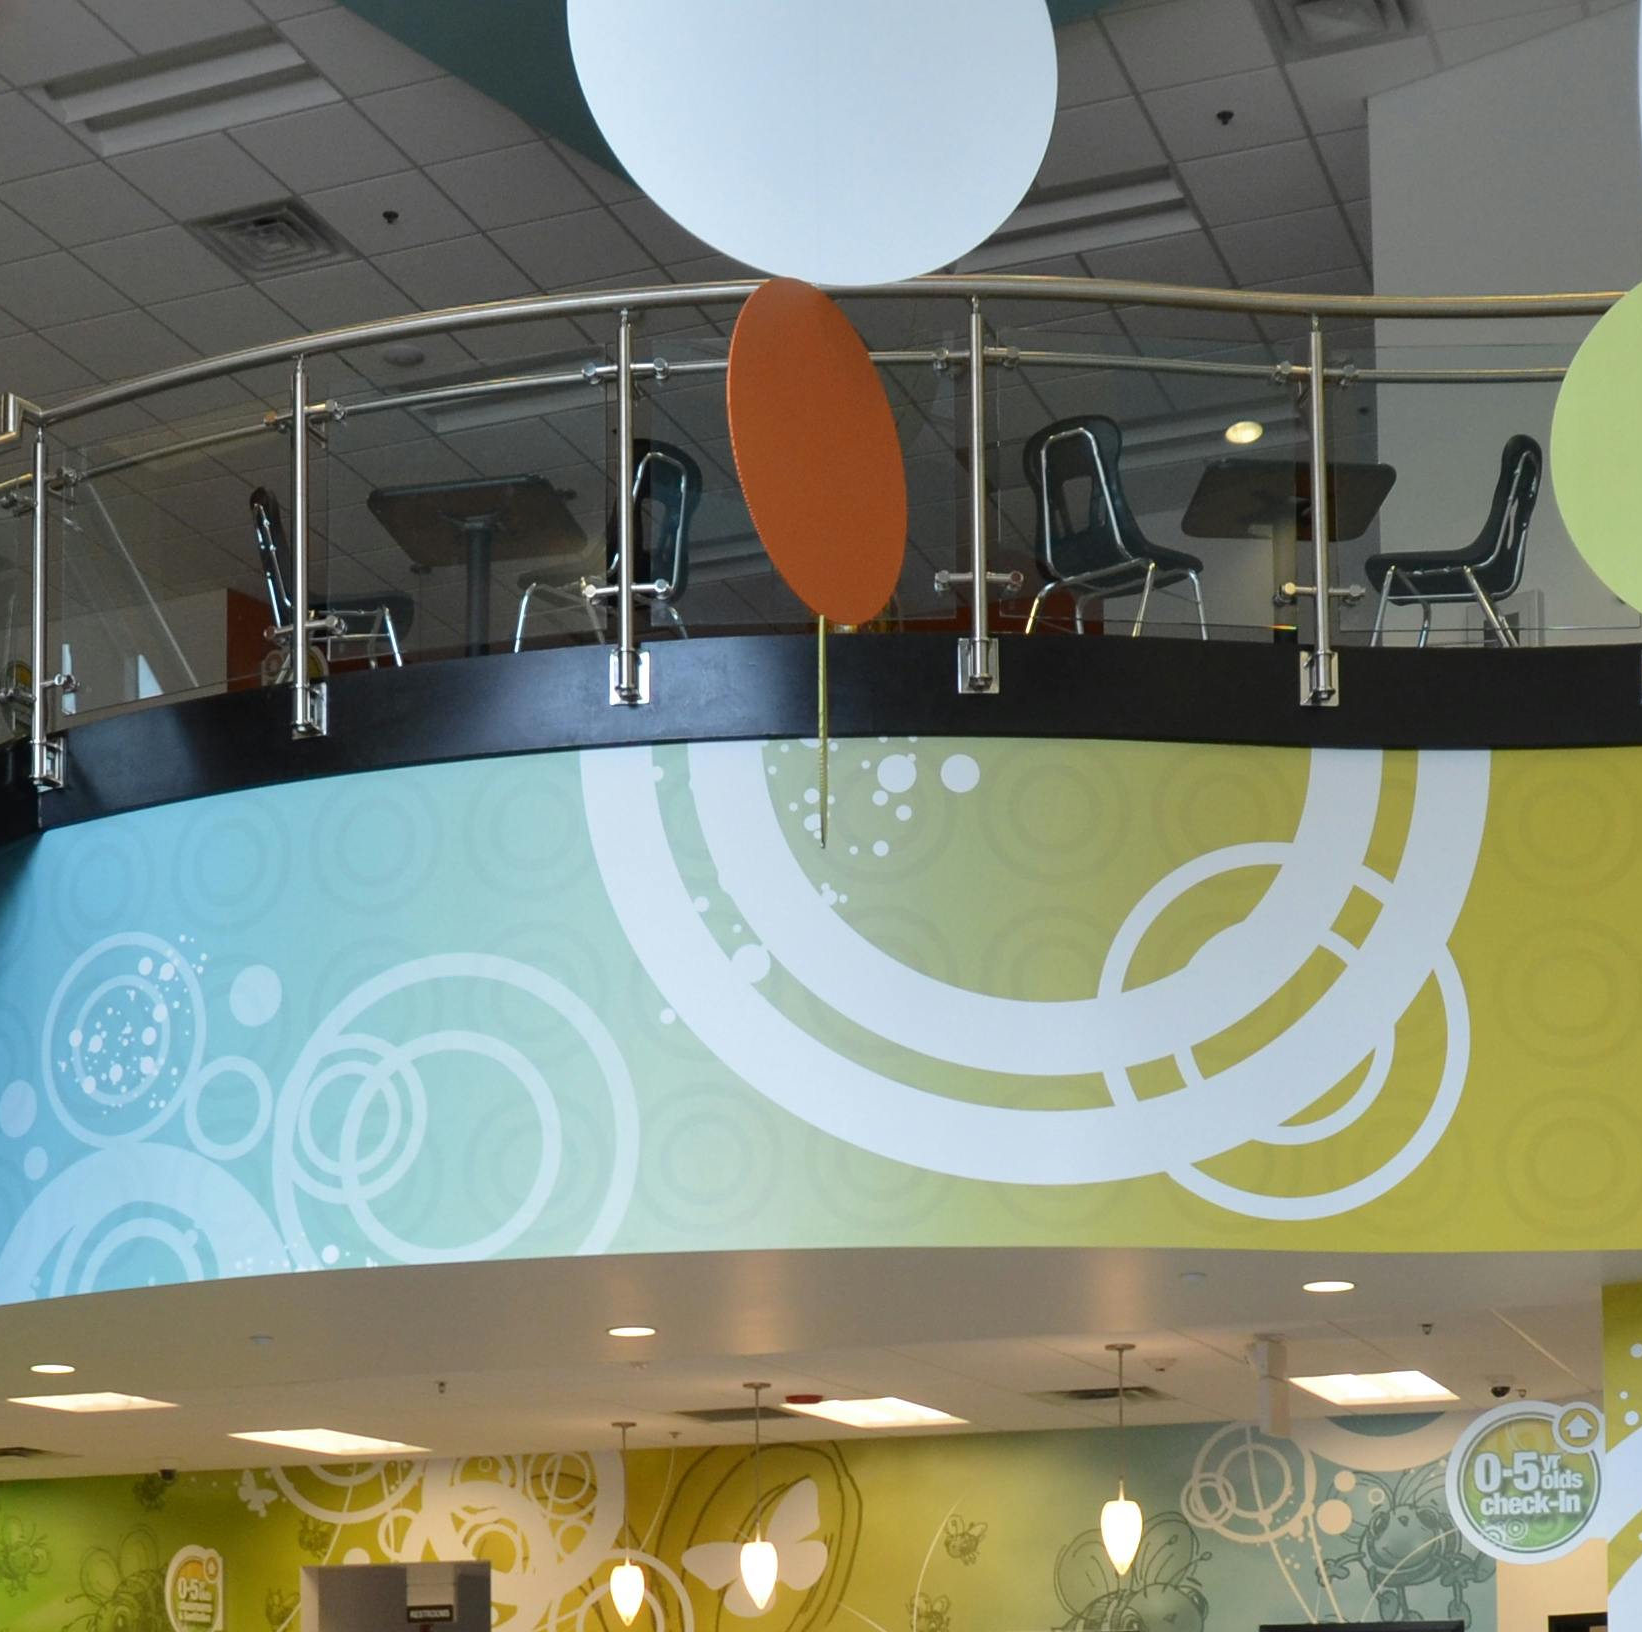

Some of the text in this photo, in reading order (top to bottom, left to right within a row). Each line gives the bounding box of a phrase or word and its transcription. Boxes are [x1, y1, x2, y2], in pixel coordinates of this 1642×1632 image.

[1474, 1451, 1583, 1493] 0-5 yr olds
[178, 1576, 198, 1600] 0-5
